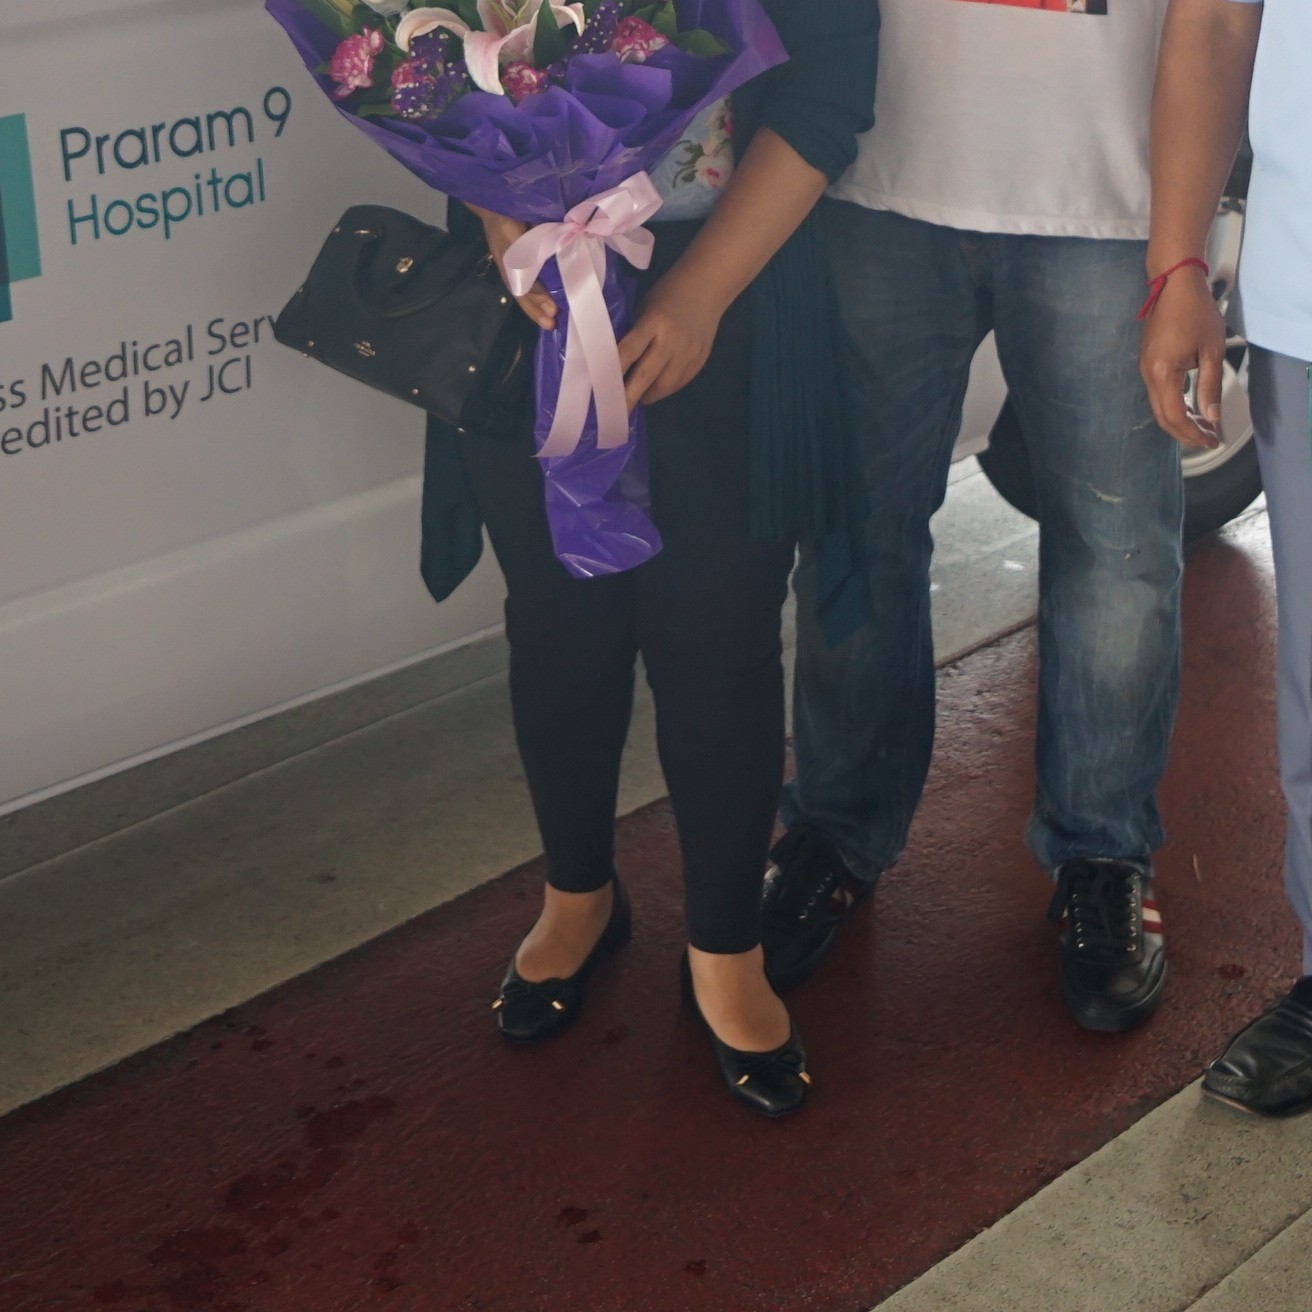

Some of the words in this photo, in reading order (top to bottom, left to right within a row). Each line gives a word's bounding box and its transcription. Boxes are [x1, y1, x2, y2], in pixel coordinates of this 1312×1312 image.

[59, 104, 255, 182] Praram
[262, 86, 292, 137] 9
[67, 158, 267, 246] Hospital
[39, 325, 195, 401] Medical
[144, 380, 190, 421] by
[201, 355, 253, 401] JCI
